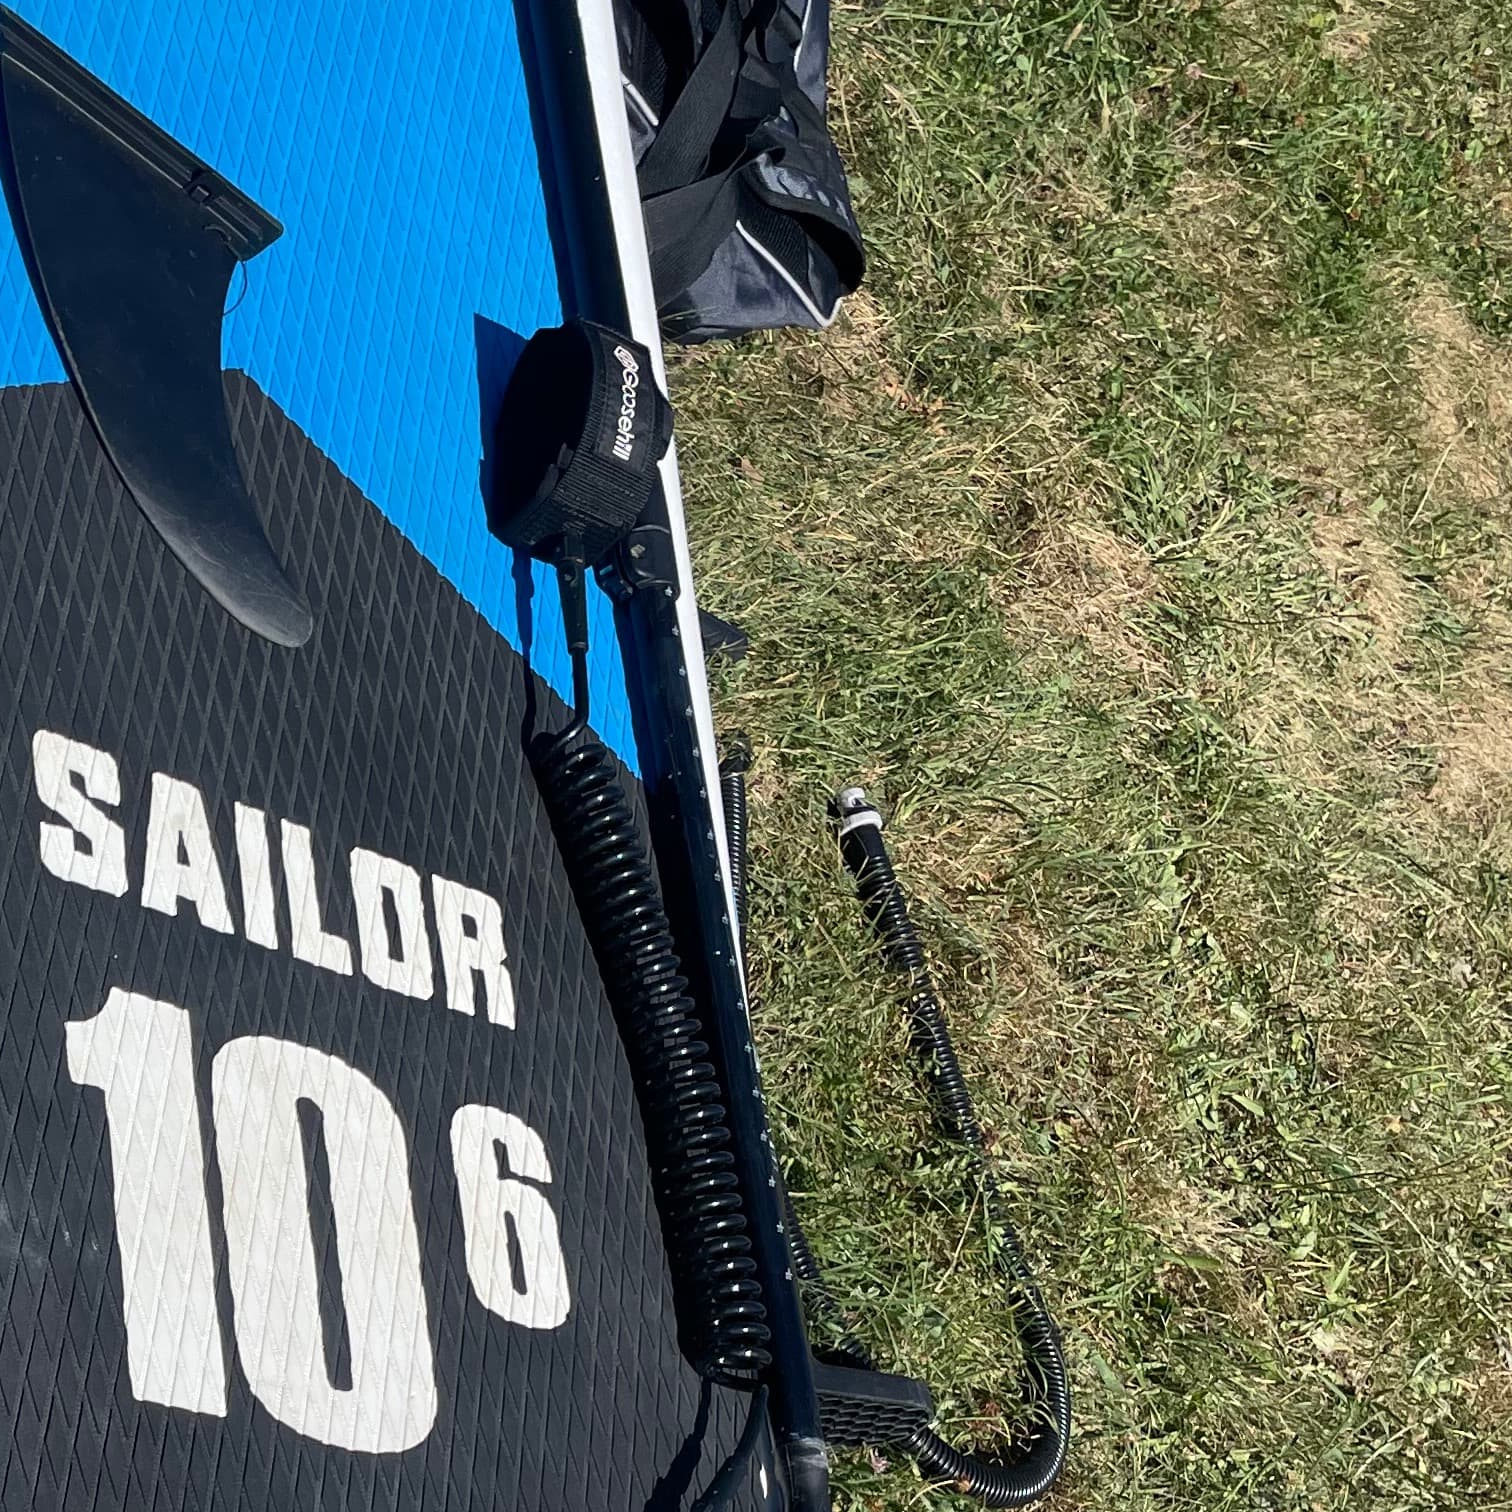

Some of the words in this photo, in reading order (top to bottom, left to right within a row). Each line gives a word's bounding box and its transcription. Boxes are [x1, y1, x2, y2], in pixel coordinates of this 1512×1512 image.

[612, 368, 640, 461] Goosehill
[32, 729, 516, 1031] SAILOR
[64, 986, 438, 1454] 10
[450, 1103, 571, 1330] 6
